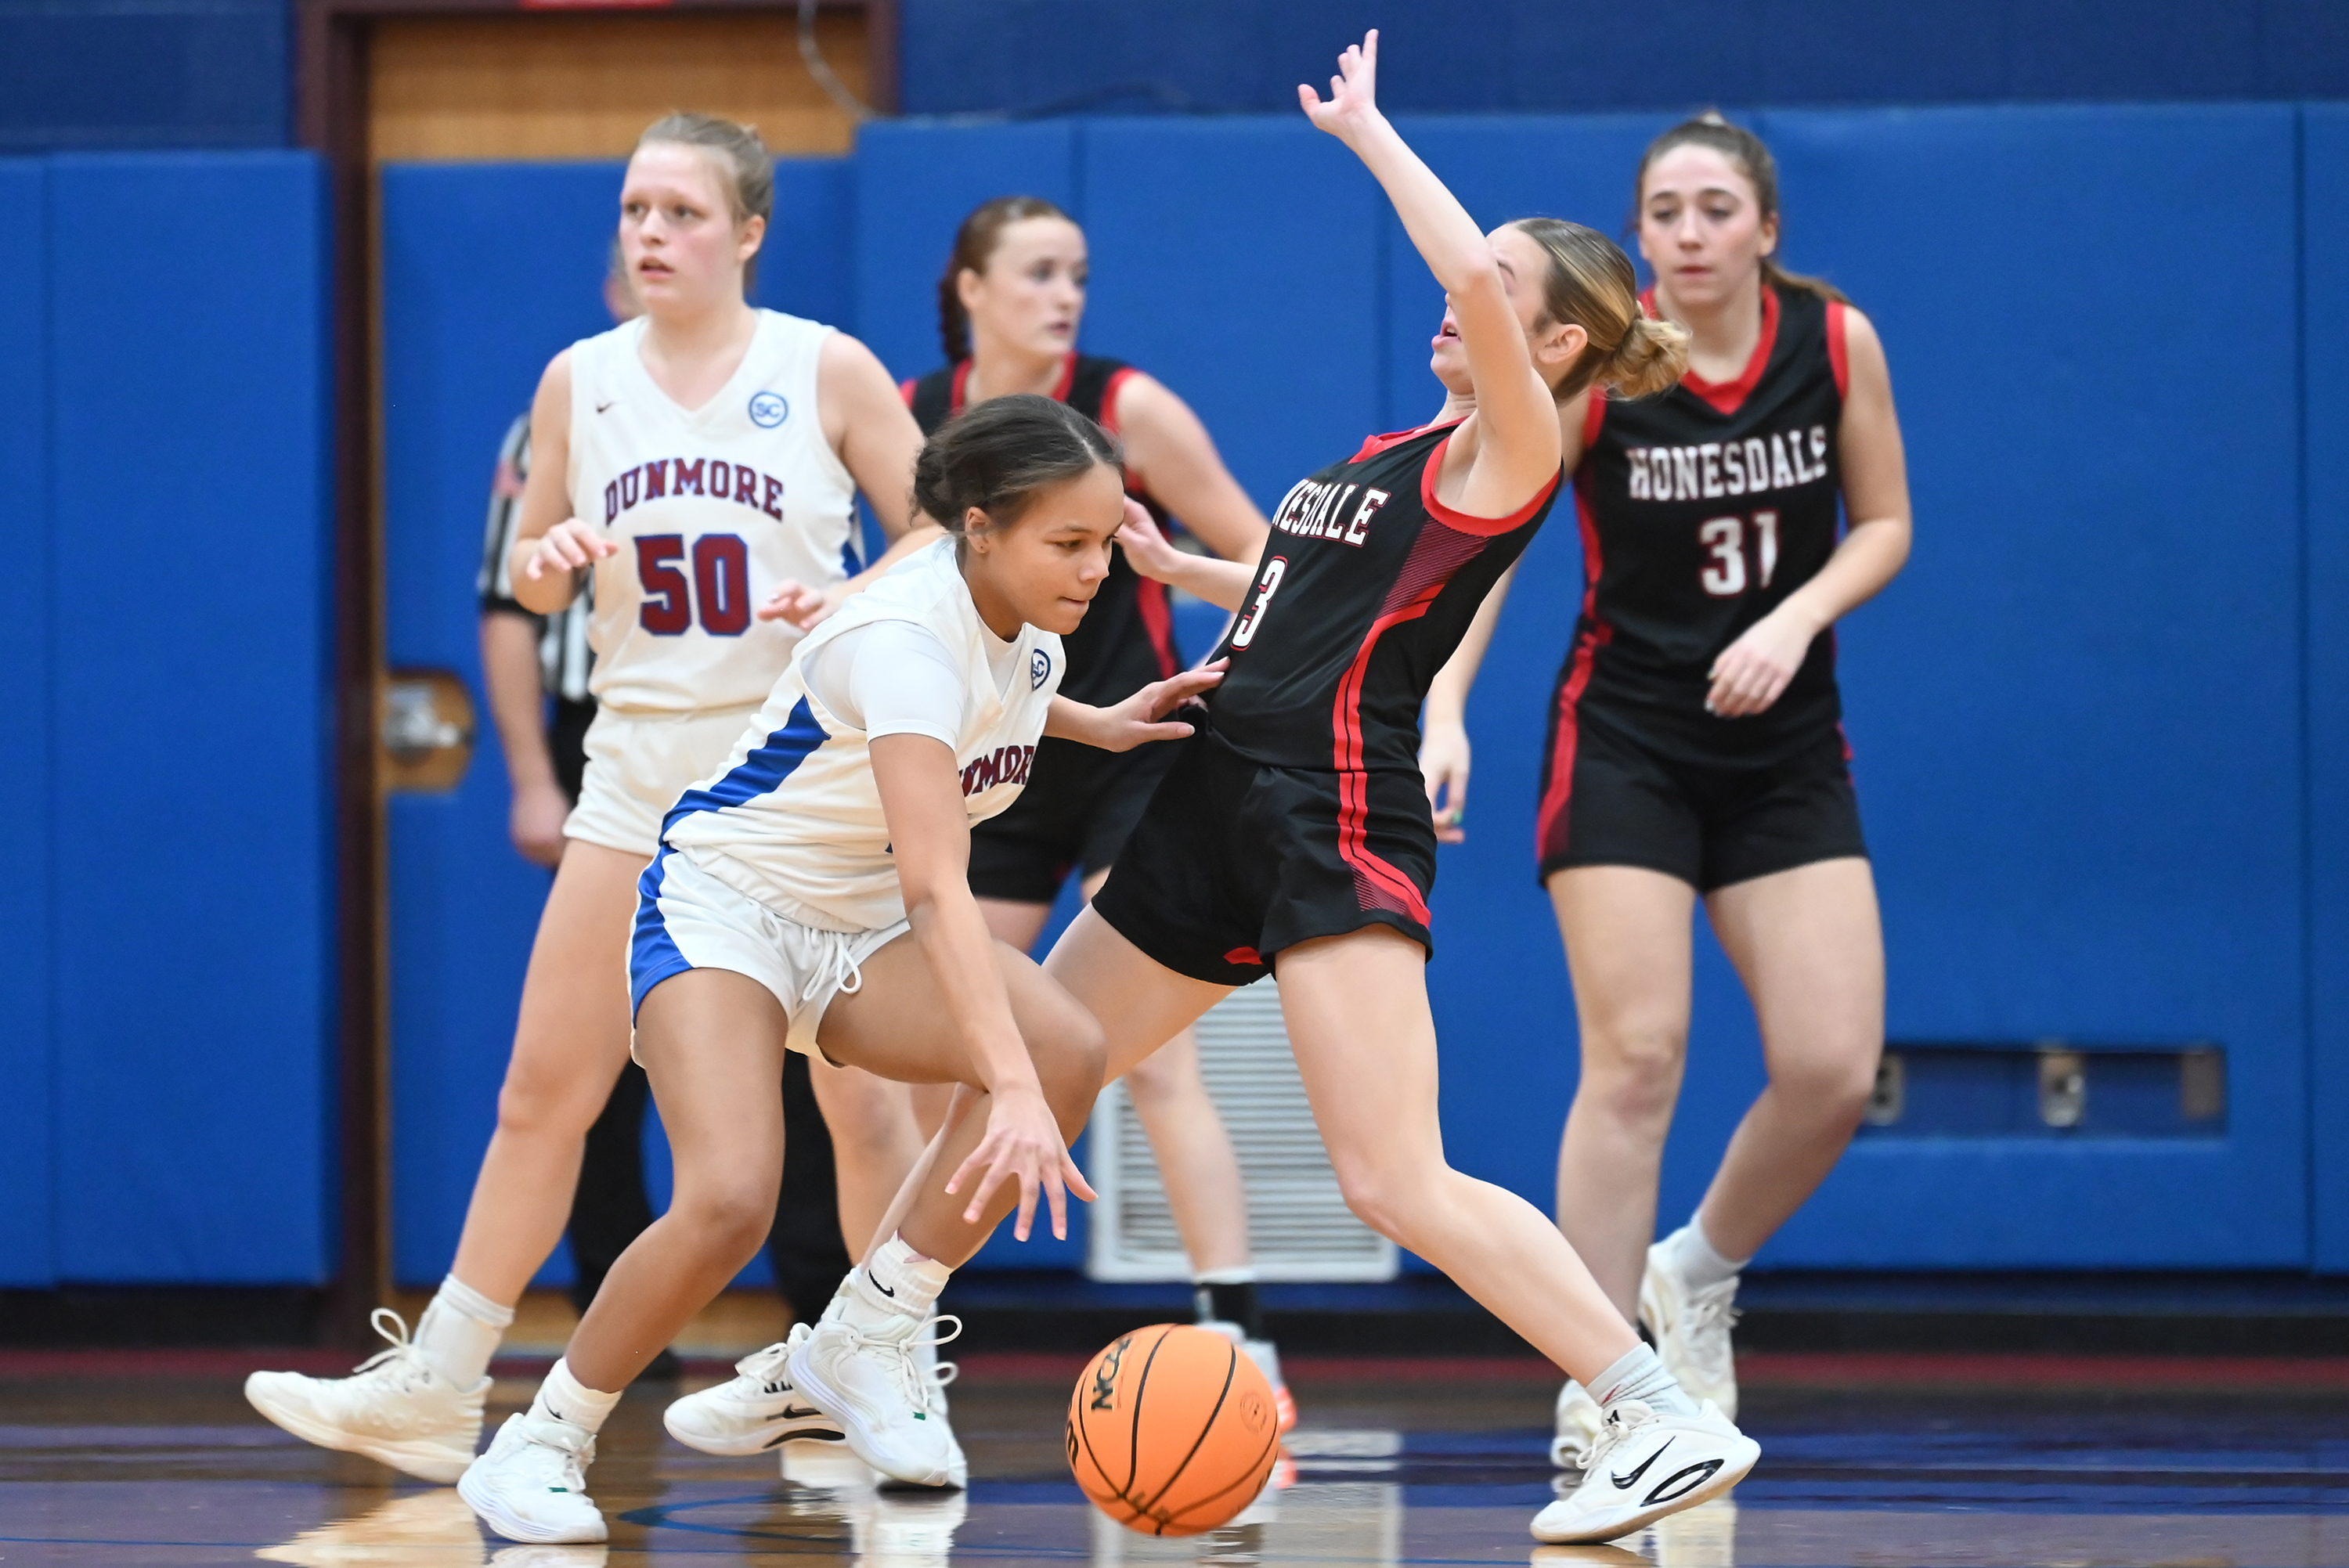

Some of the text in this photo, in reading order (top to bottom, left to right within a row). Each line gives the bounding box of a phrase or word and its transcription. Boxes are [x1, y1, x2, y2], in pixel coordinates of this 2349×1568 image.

[605, 457, 785, 526] DUNMORE
[635, 533, 752, 636] 50
[1699, 510, 1779, 597] 31
[1230, 555, 1289, 651] 3
